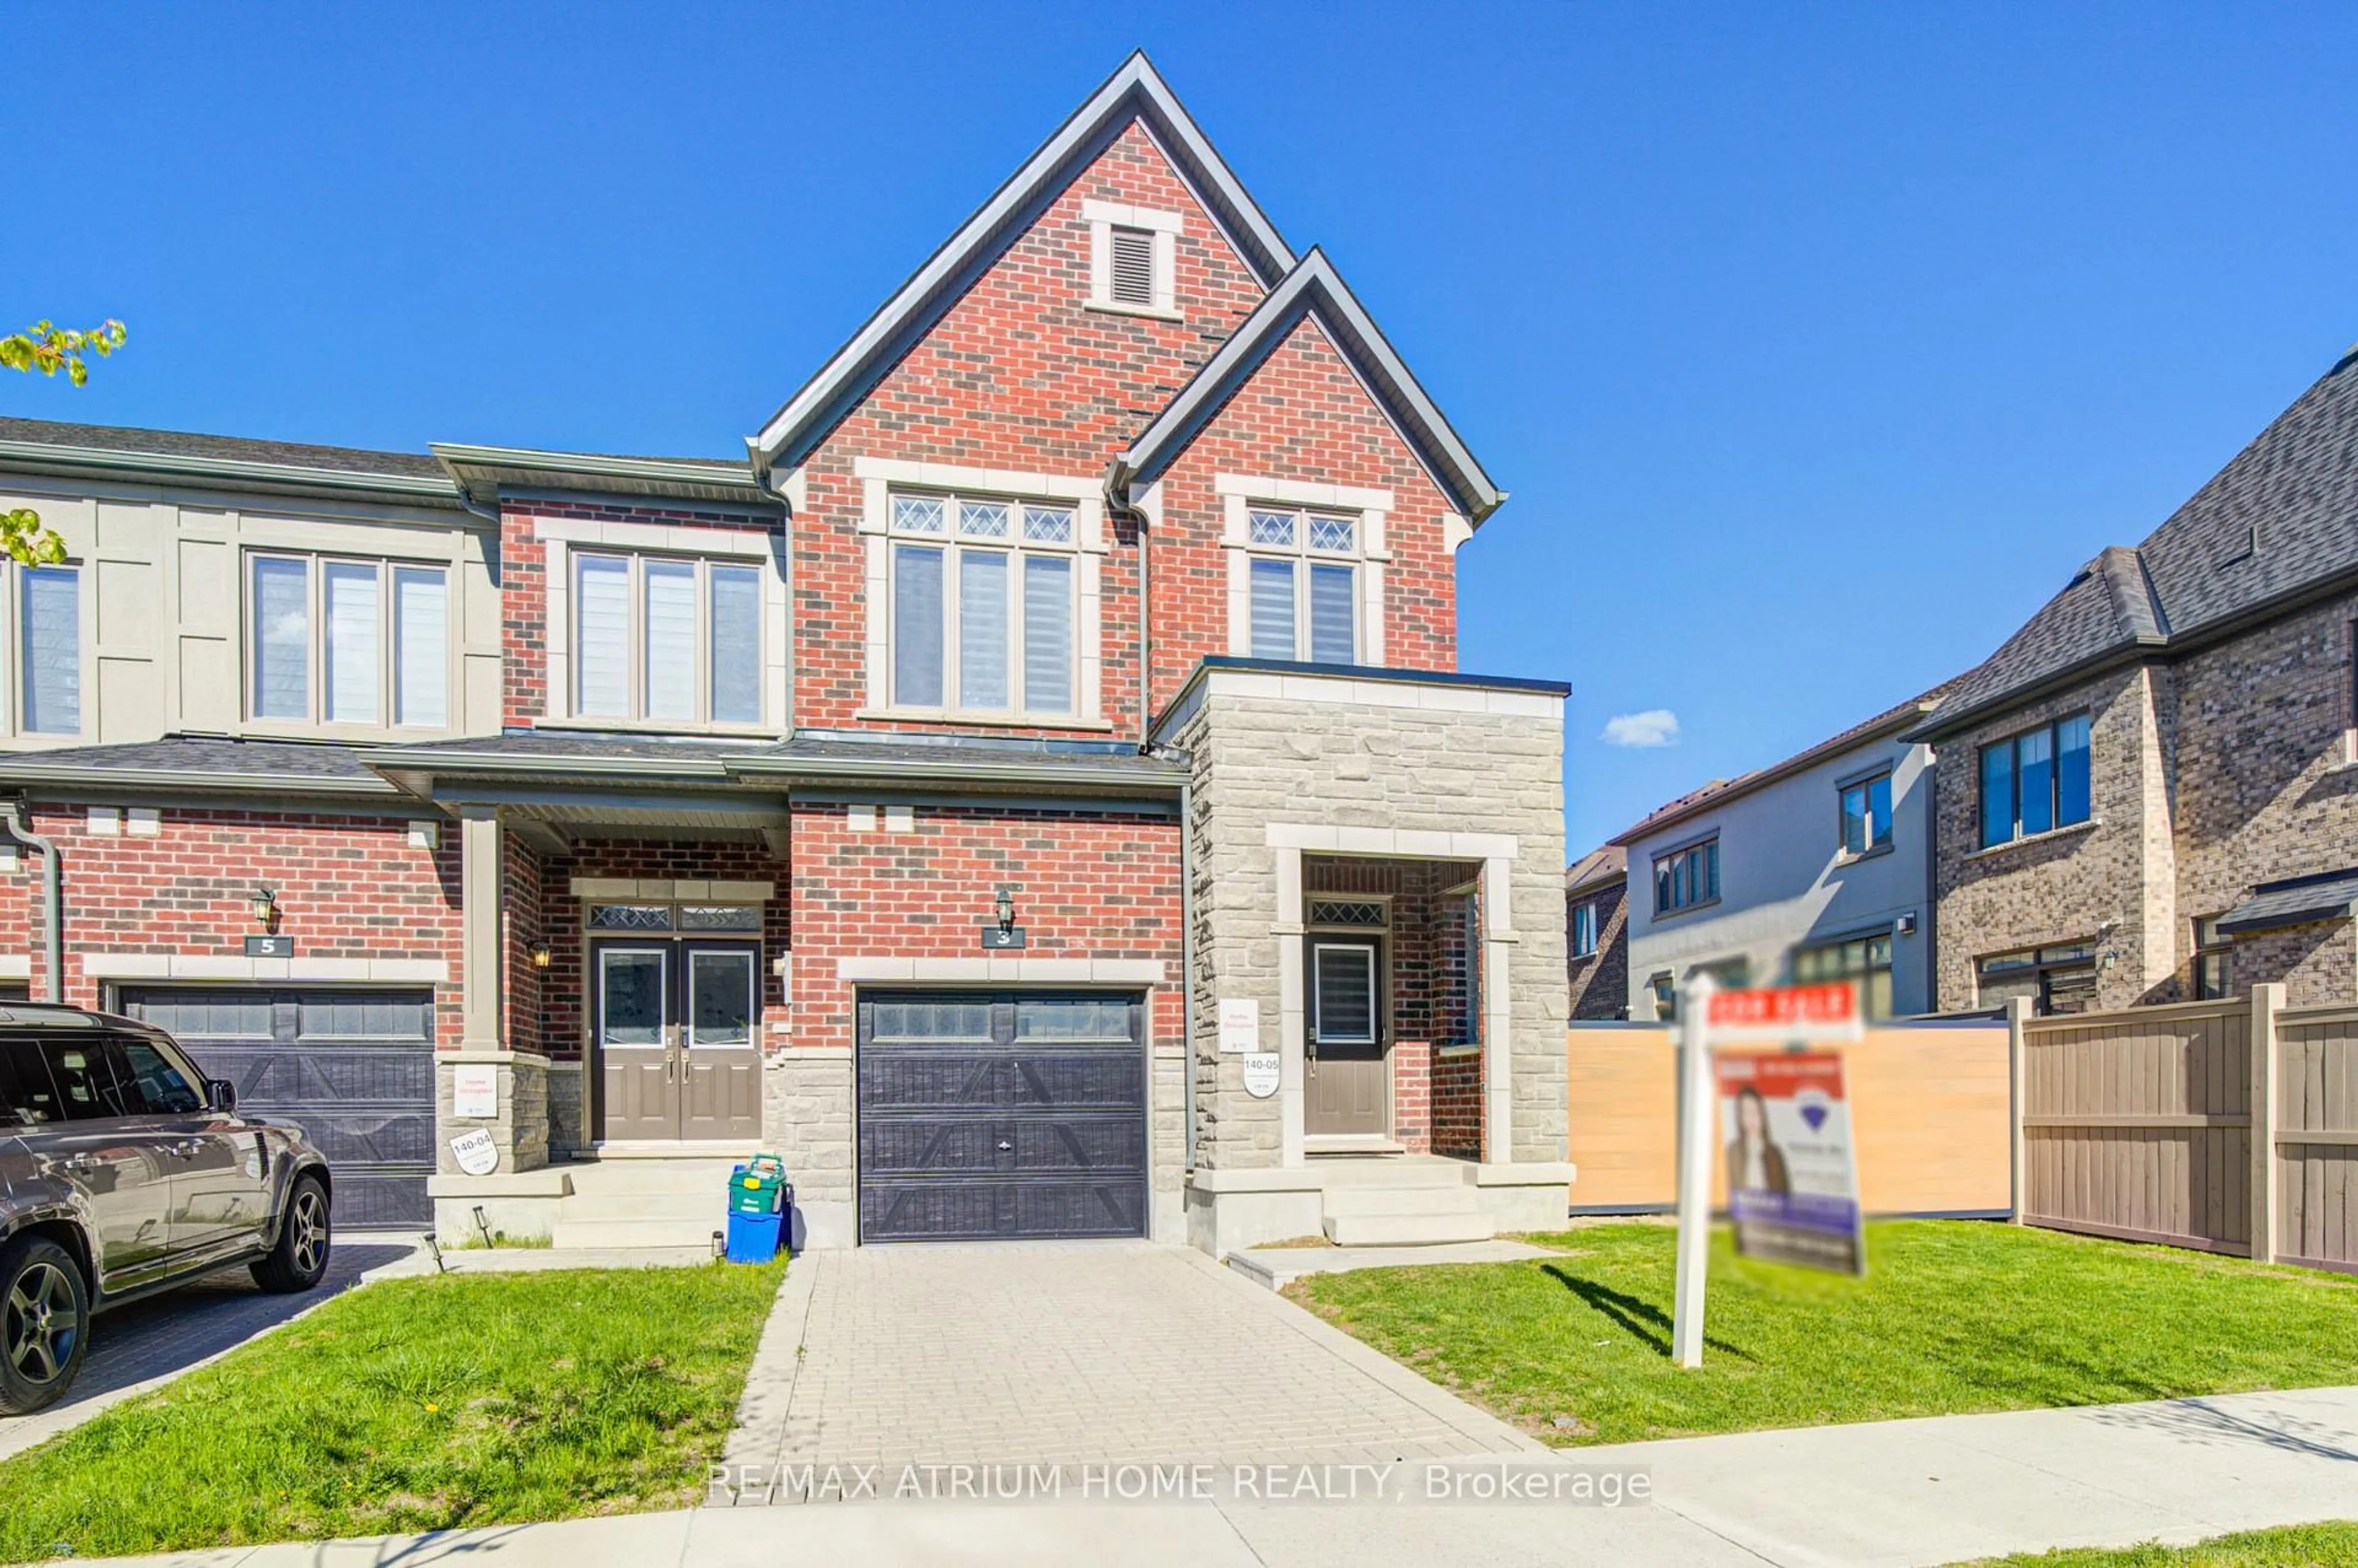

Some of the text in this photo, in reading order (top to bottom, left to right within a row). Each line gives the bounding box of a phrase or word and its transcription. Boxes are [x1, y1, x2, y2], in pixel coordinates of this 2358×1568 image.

[997, 930, 1010, 944] 3
[261, 939, 275, 953] 5
[1246, 1060, 1278, 1069] 140-05
[454, 1134, 490, 1154] 140-04
